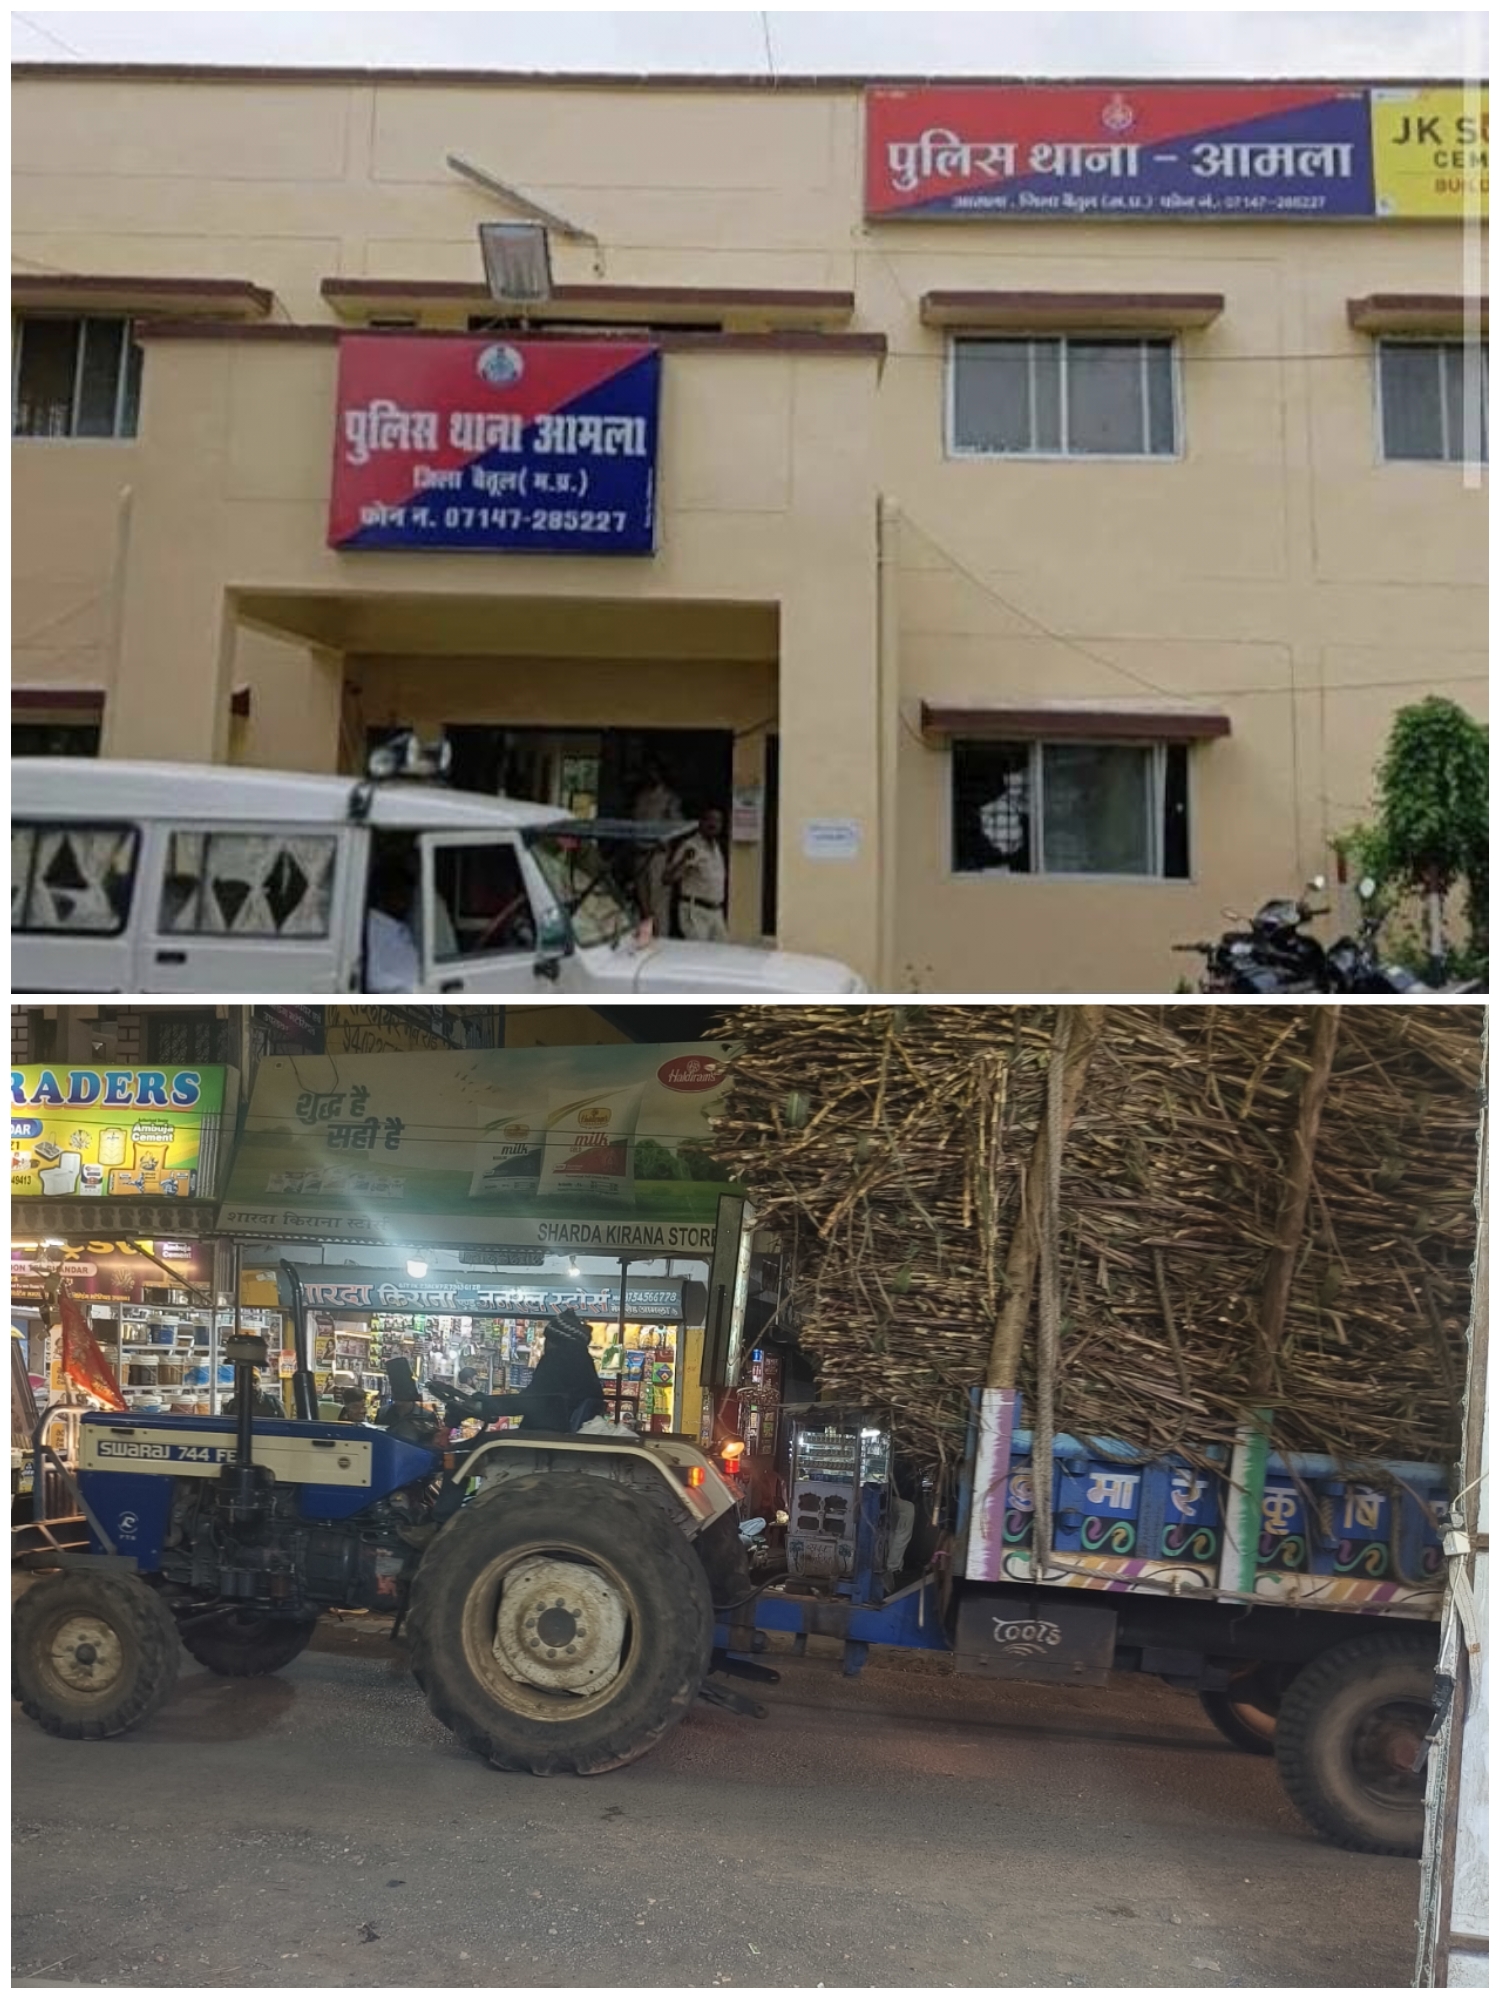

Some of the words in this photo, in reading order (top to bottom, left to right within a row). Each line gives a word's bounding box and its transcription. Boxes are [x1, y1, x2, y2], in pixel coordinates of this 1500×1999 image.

[1391, 117, 1443, 145] JK
[887, 128, 1017, 190] पुलिस
[1029, 142, 1141, 178] थाना
[1191, 142, 1354, 178] आमला
[345, 400, 439, 464] पुलिस
[450, 411, 523, 454] थाना
[533, 413, 648, 456] आमला
[445, 507, 627, 533] 07147-285227
[295, 1091, 346, 1125] शुद्ध
[349, 1085, 371, 1117] है
[131, 1132, 174, 1142] Cement
[132, 1122, 174, 1135] Ambuja
[326, 1115, 381, 1150] सही
[384, 1115, 406, 1151] है
[574, 1132, 609, 1148] milk
[501, 1143, 528, 1155] milk
[226, 1210, 278, 1225] शारदा
[282, 1211, 342, 1228] किराना
[538, 1223, 602, 1244] SHARDA
[606, 1225, 665, 1246] KIRANA
[162, 1251, 192, 1259] Cement
[378, 1282, 457, 1309] किराना
[177, 1446, 210, 1462] 744
